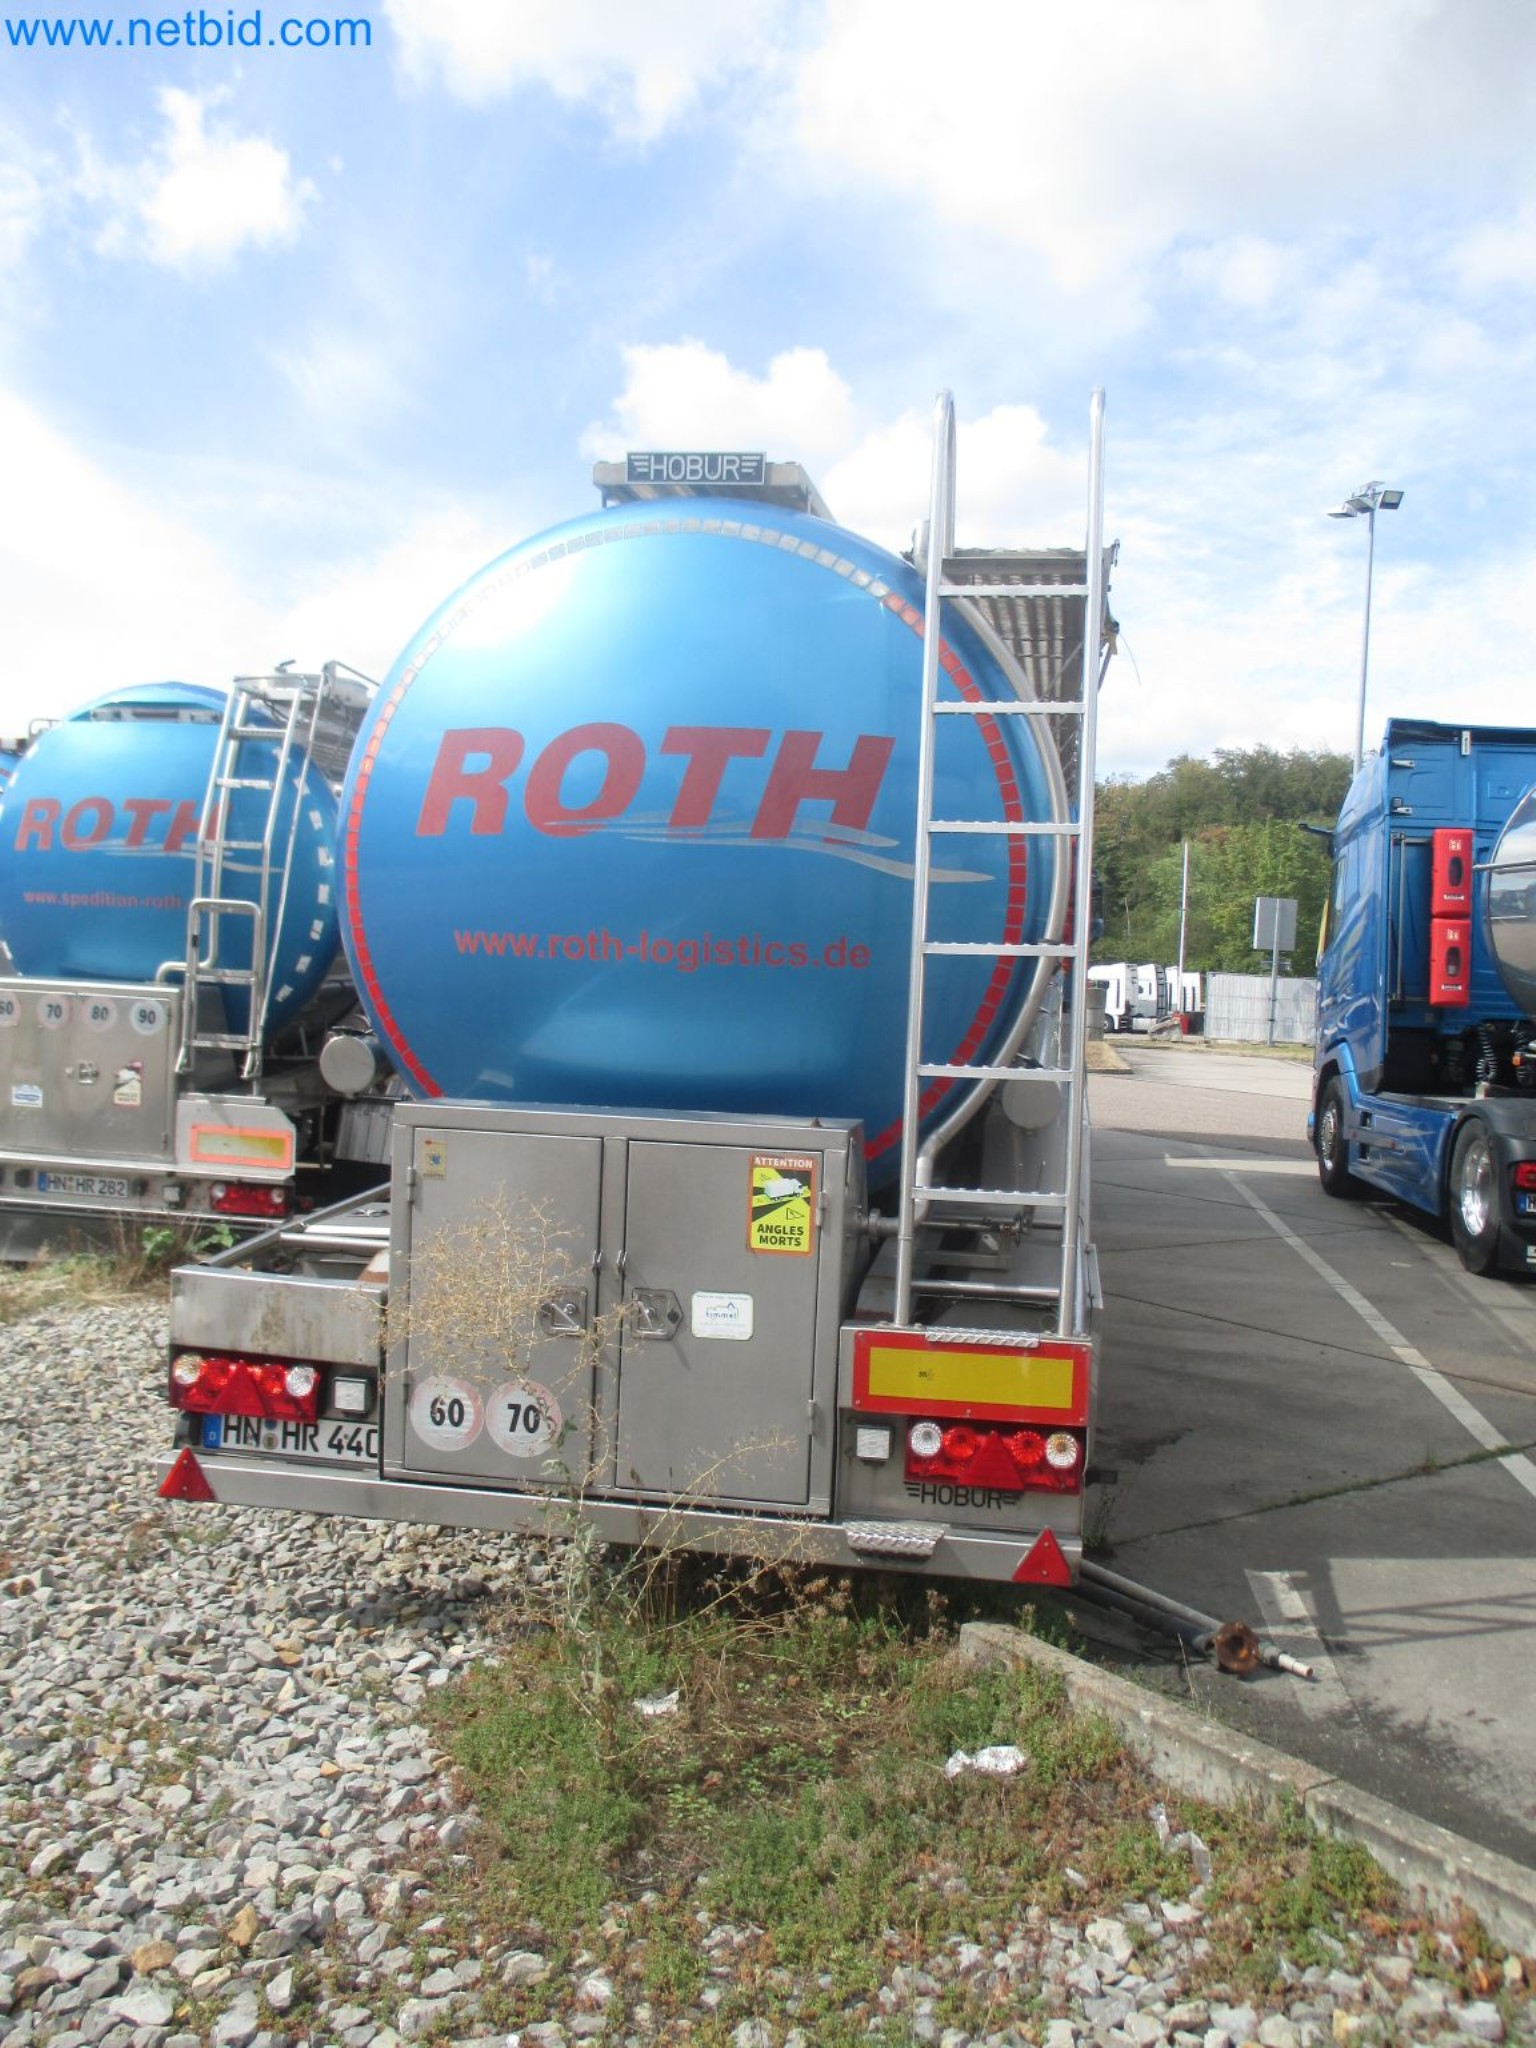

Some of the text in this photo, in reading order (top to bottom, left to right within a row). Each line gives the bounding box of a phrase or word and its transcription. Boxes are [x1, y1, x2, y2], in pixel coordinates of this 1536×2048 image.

[651, 455, 740, 481] HOBUR
[415, 722, 897, 845] ROTH
[14, 797, 232, 854] ROTH
[453, 929, 872, 973] www.roth-logistics.de
[47, 1003, 62, 1019] 70
[91, 1006, 109, 1022] 80
[138, 1009, 156, 1025] 90
[755, 1157, 813, 1169] ATTENTION
[76, 1178, 96, 1194] HR
[757, 1224, 804, 1236] ANGLES
[759, 1235, 802, 1247] MORTS
[430, 1396, 464, 1428] 60
[507, 1403, 540, 1434] 70
[223, 1414, 262, 1448] HN
[281, 1421, 319, 1453] HR
[921, 1483, 1002, 1510] HOBUR
